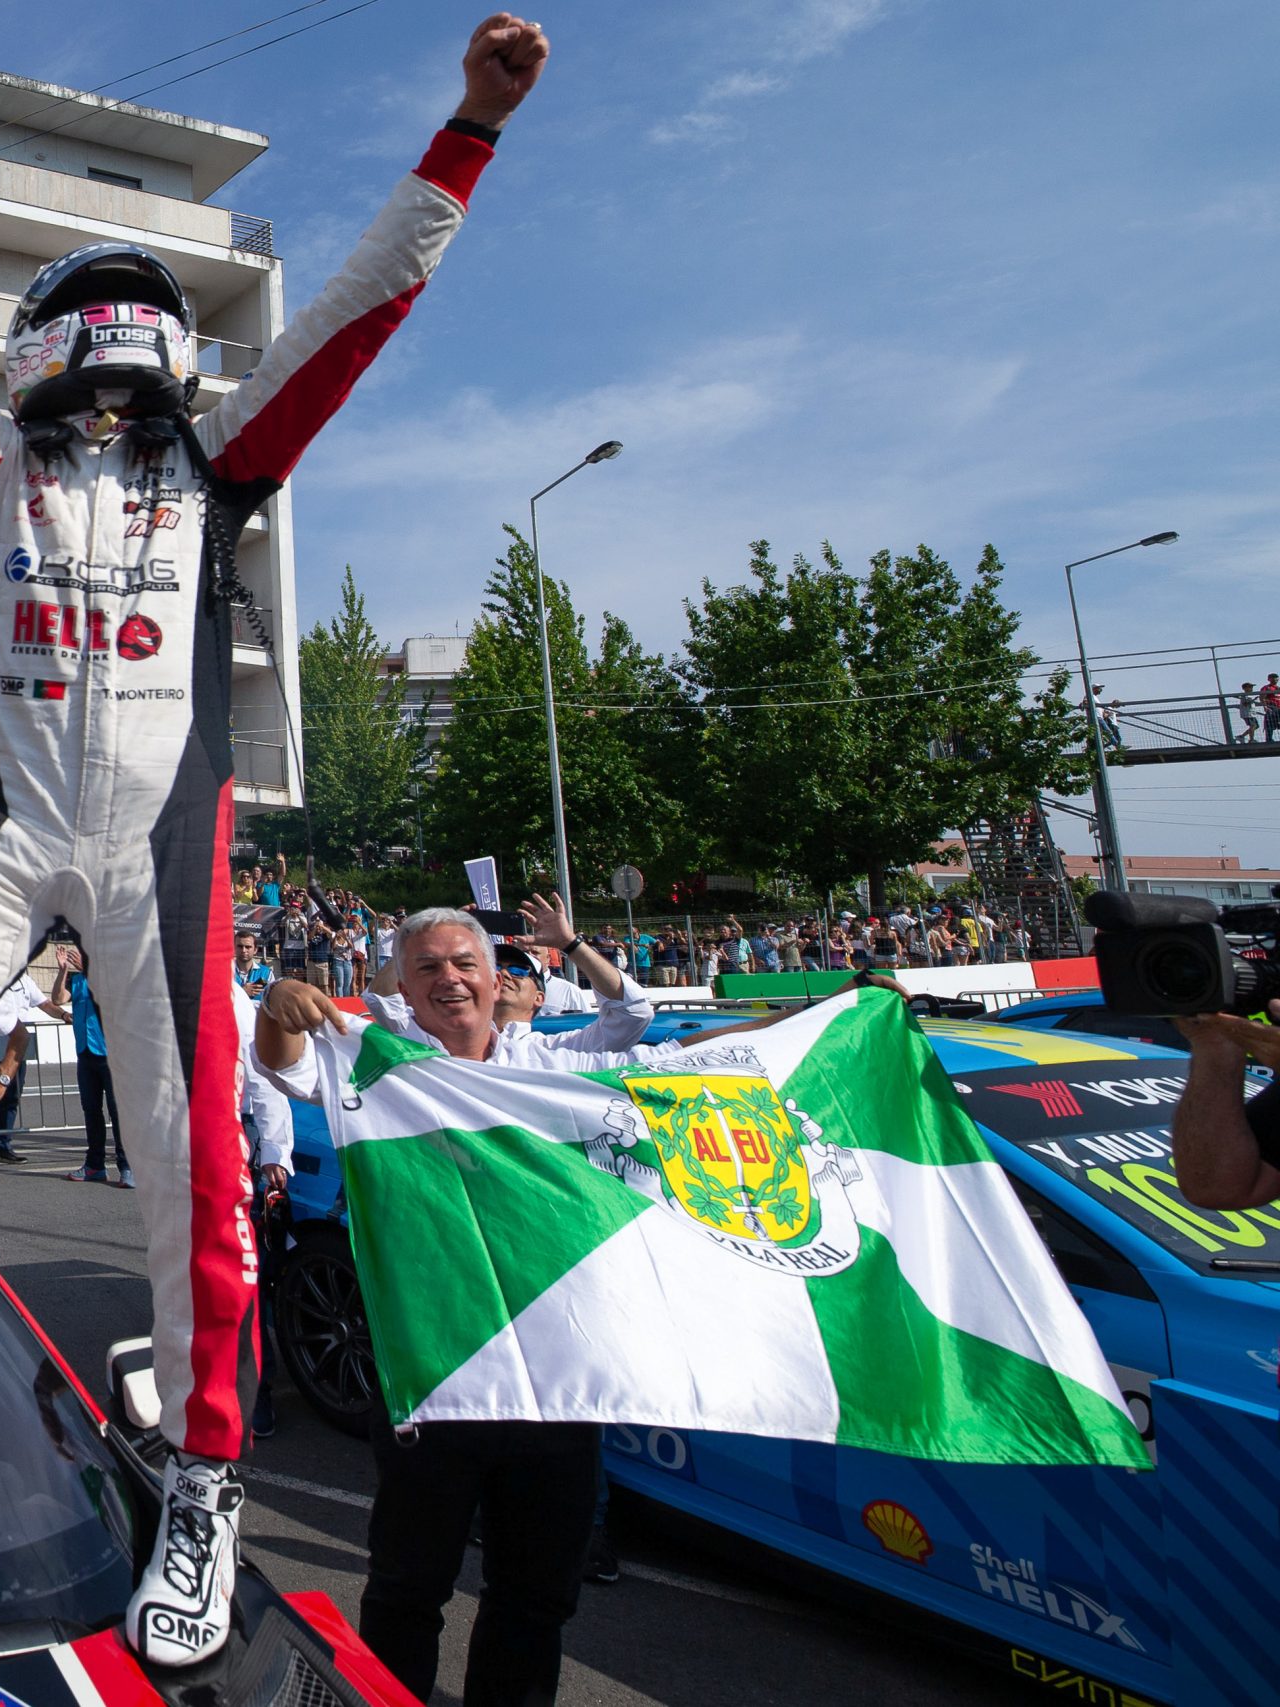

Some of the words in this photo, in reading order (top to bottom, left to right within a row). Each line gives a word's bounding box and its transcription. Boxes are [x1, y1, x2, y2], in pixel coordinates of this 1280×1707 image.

[91, 326, 156, 344] brose
[13, 600, 110, 652] HELL
[11, 645, 55, 656] ENERGY
[1, 679, 24, 692] OMP
[101, 688, 113, 699] T.
[115, 688, 185, 701] MONTEIRO
[692, 1127, 732, 1162] AL
[732, 1129, 771, 1164] EU
[780, 1242, 850, 1270] REAL
[176, 1476, 207, 1499] OMP
[970, 1543, 1037, 1583] Shell
[972, 1566, 1147, 1653] HELIX
[152, 1613, 220, 1648] OMP
